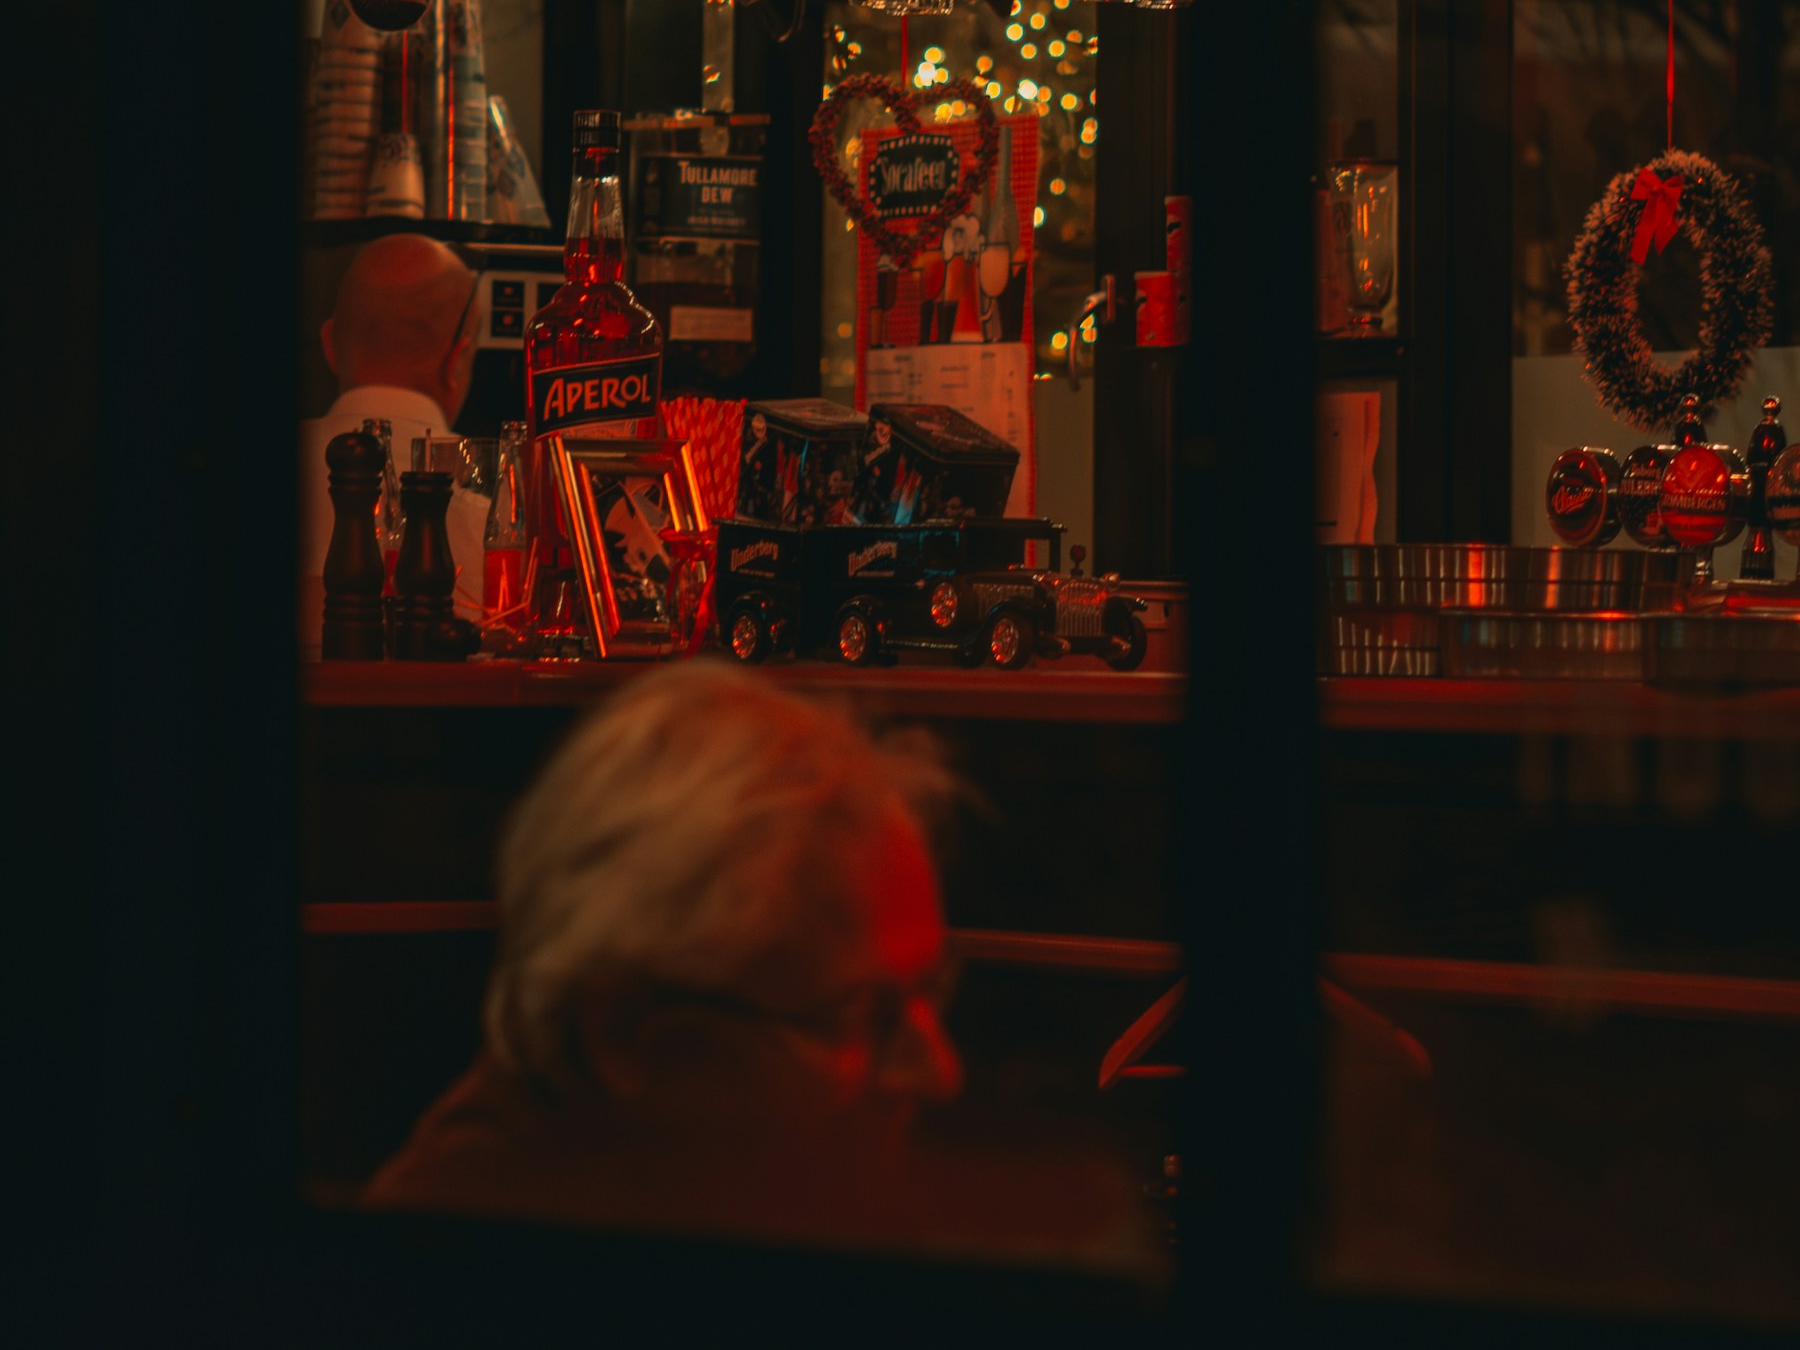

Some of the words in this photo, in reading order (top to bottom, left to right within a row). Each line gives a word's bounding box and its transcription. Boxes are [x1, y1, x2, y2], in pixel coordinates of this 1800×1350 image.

[677, 160, 758, 187] TULLAMORE
[701, 186, 733, 204] DEW
[542, 373, 652, 423] APEROL
[730, 539, 780, 573] Underberg
[847, 539, 898, 578] Underberg
